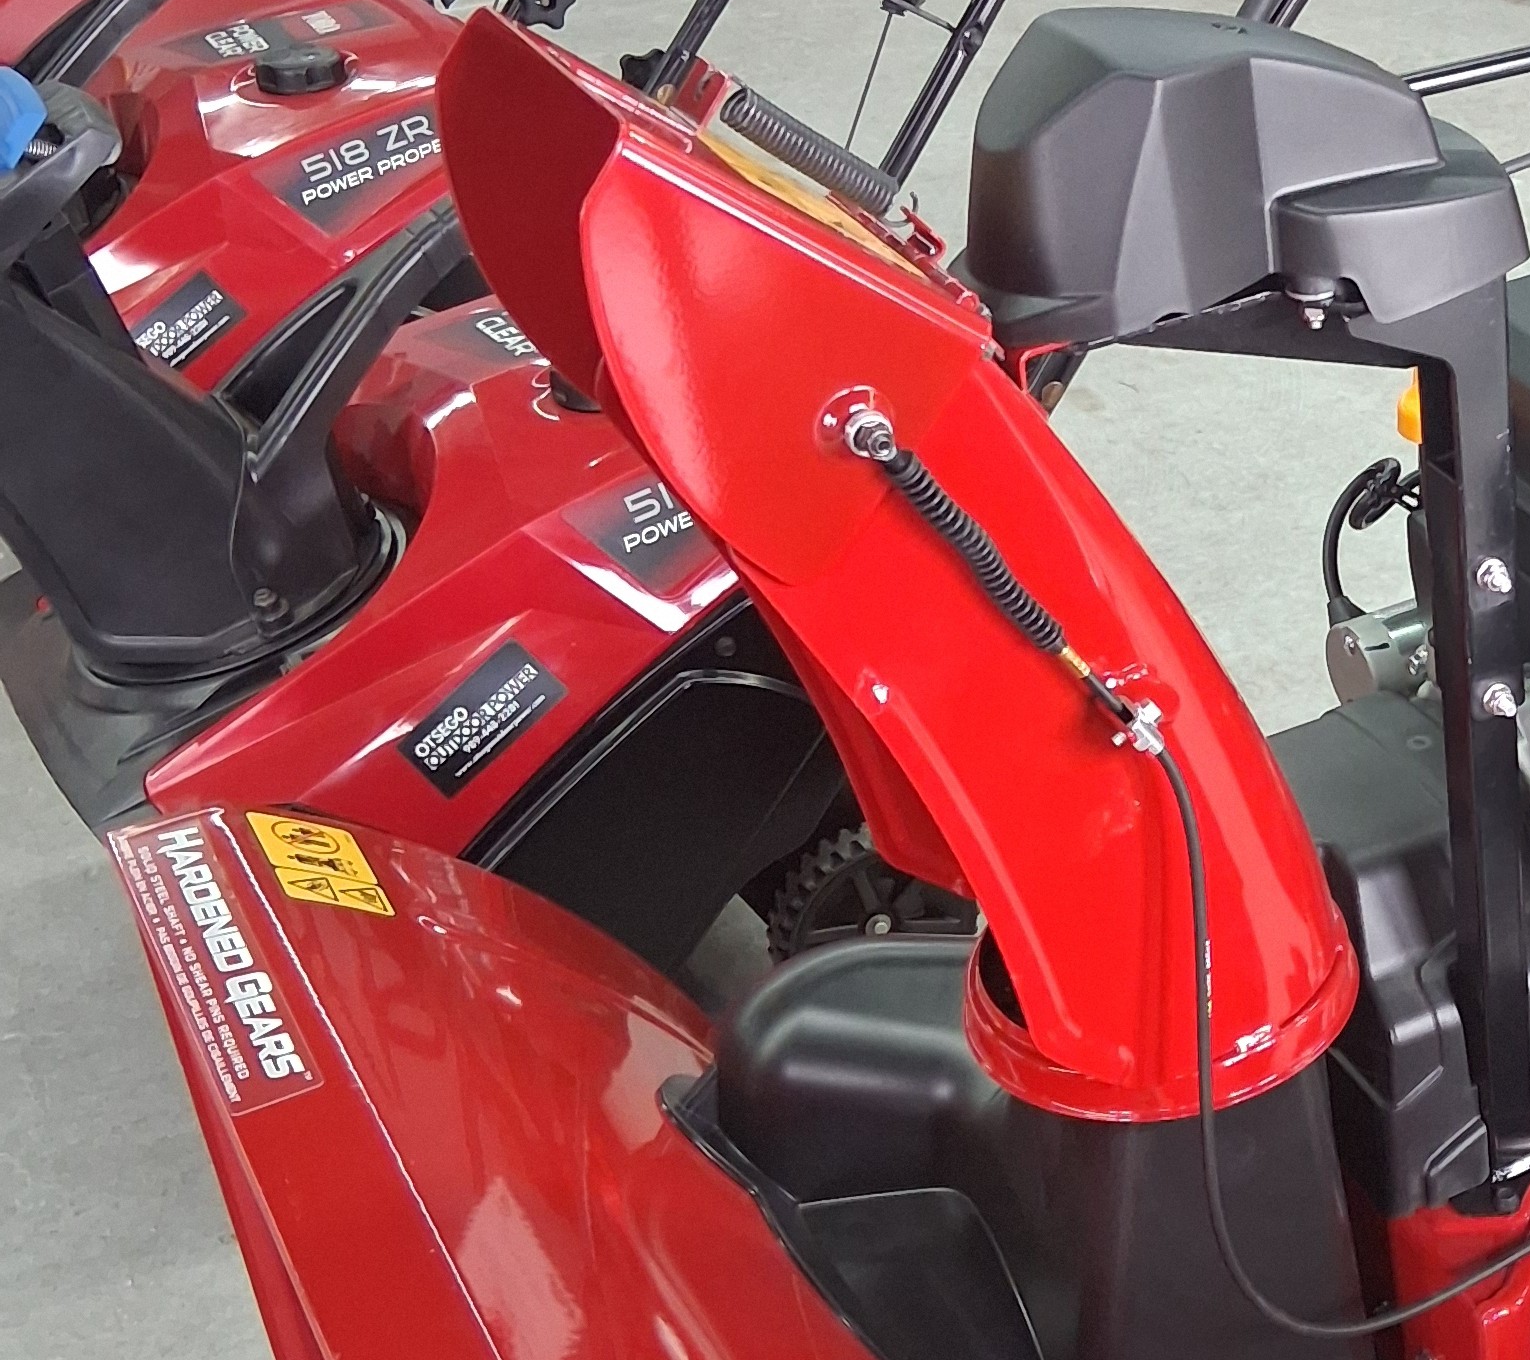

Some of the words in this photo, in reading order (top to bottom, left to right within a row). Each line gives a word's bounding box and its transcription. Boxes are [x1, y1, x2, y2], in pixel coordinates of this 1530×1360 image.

[300, 139, 370, 183] 518
[376, 115, 435, 152] ZR
[302, 166, 374, 206] POWER
[376, 138, 442, 176] PROPE
[181, 288, 223, 328] POWER
[134, 319, 166, 349] SEGO
[475, 316, 539, 356] CLEAR
[624, 482, 674, 524] 51
[623, 511, 694, 552] POWE
[414, 708, 467, 757] OTSEGO
[422, 705, 493, 771] OUTDOOR
[485, 662, 539, 712] POWER
[148, 872, 171, 905] STEEL
[162, 903, 186, 938] SHAFT
[157, 825, 254, 974] HARDENED
[224, 970, 305, 1080] GEARS
[180, 945, 197, 963] NO
[187, 961, 213, 998] SHEAR
[203, 997, 224, 1024] PINS
[215, 1023, 250, 1081] REQUIRED
